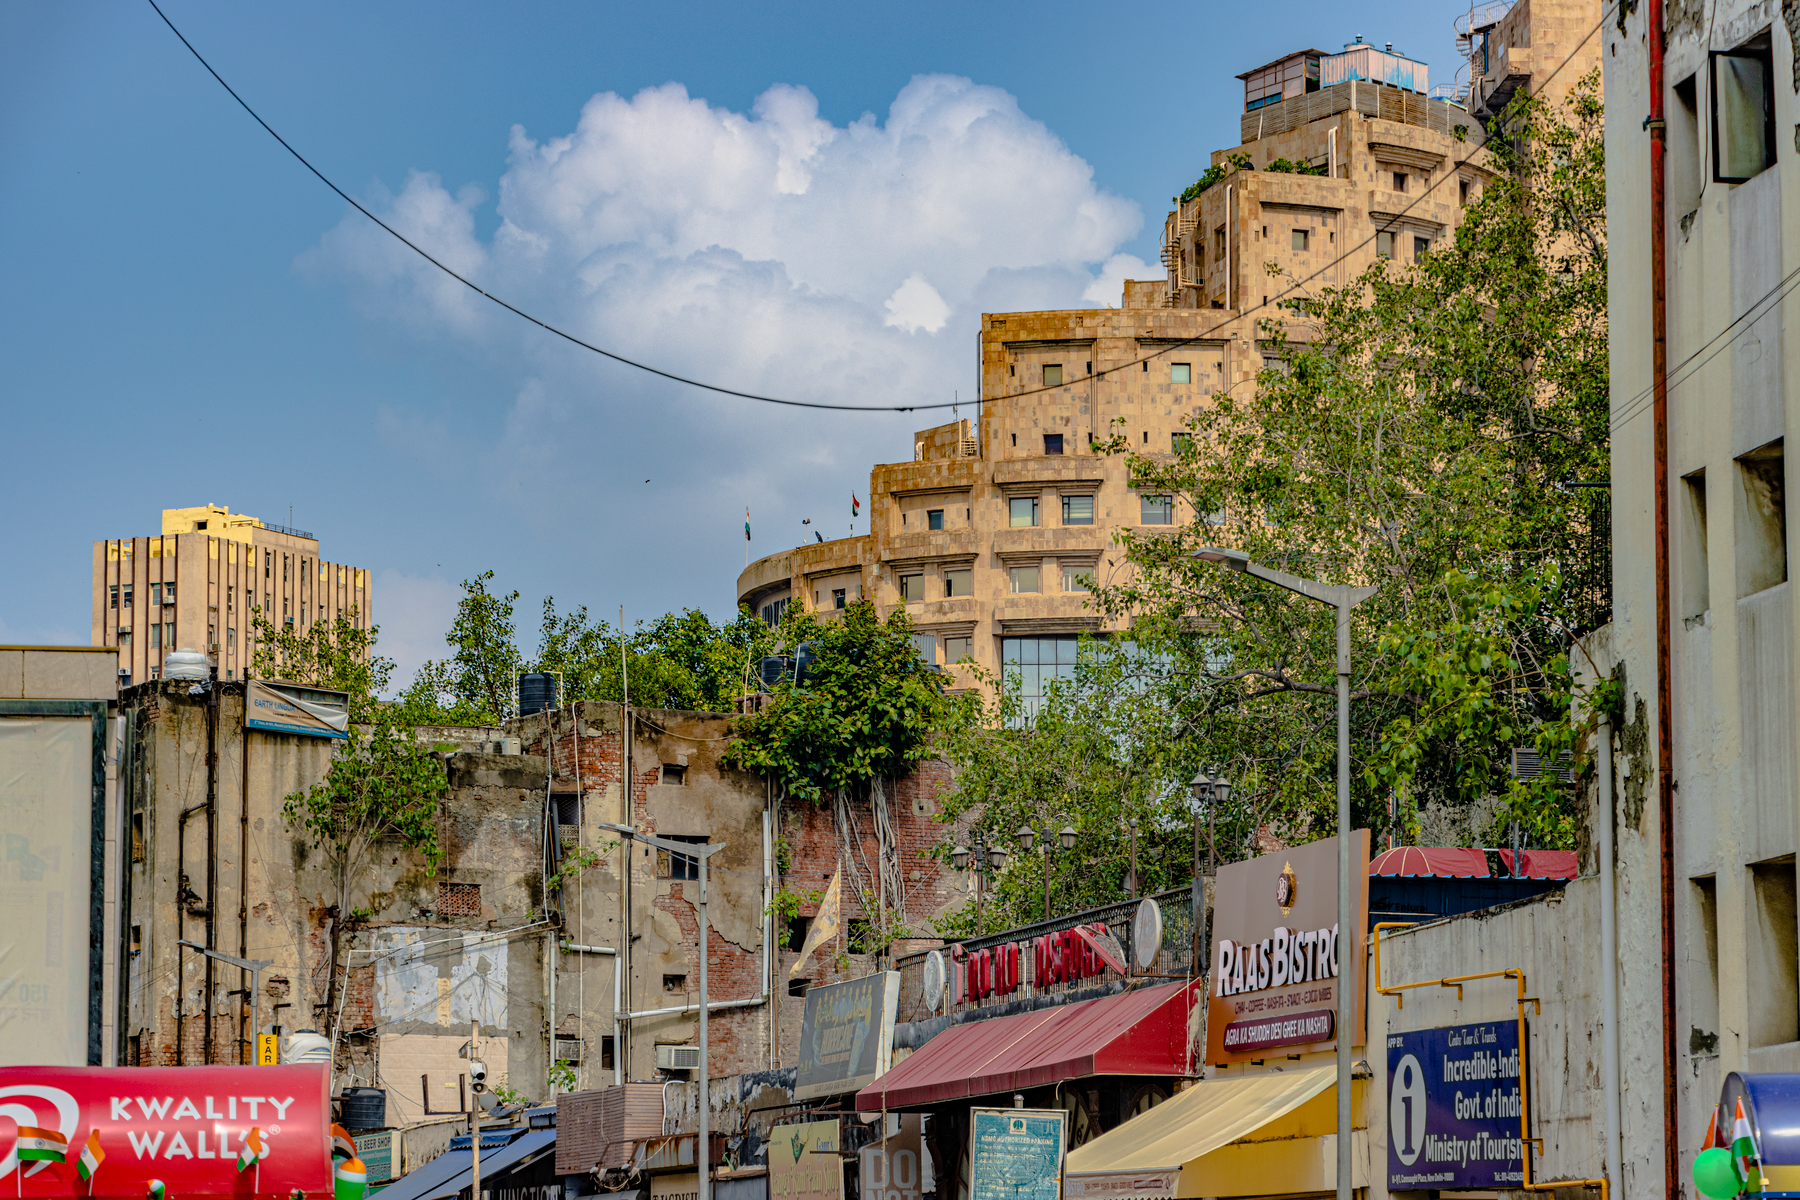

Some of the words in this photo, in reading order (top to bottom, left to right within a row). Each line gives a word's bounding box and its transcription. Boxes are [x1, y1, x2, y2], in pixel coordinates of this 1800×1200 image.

[254, 699, 273, 709] EARTH
[1216, 939, 1272, 997] RAAS
[1224, 1028, 1240, 1046] AGRA
[1240, 1026, 1248, 1044] KA
[1248, 1024, 1270, 1043] SHUDDH
[1271, 1022, 1282, 1040] DESI
[1282, 1020, 1297, 1039] GHEE
[1297, 1018, 1305, 1036] KA
[1306, 1016, 1328, 1036] NASHTA
[1388, 1038, 1396, 1048] APP
[1462, 1029, 1474, 1046] Tour
[1474, 1028, 1479, 1044] &
[1480, 1026, 1497, 1044] Travels
[264, 1036, 272, 1066] EAR
[1443, 1050, 1496, 1082] Incredible
[110, 1095, 295, 1121] KWALITY
[1455, 1090, 1483, 1120] Govt.
[1485, 1088, 1497, 1118] of
[364, 1138, 376, 1150] BEER
[377, 1136, 391, 1148] SHOP
[1425, 1134, 1468, 1169] Ministry
[1470, 1132, 1481, 1161] of
[823, 1160, 839, 1200] Shop
[865, 1148, 917, 1190] DO
